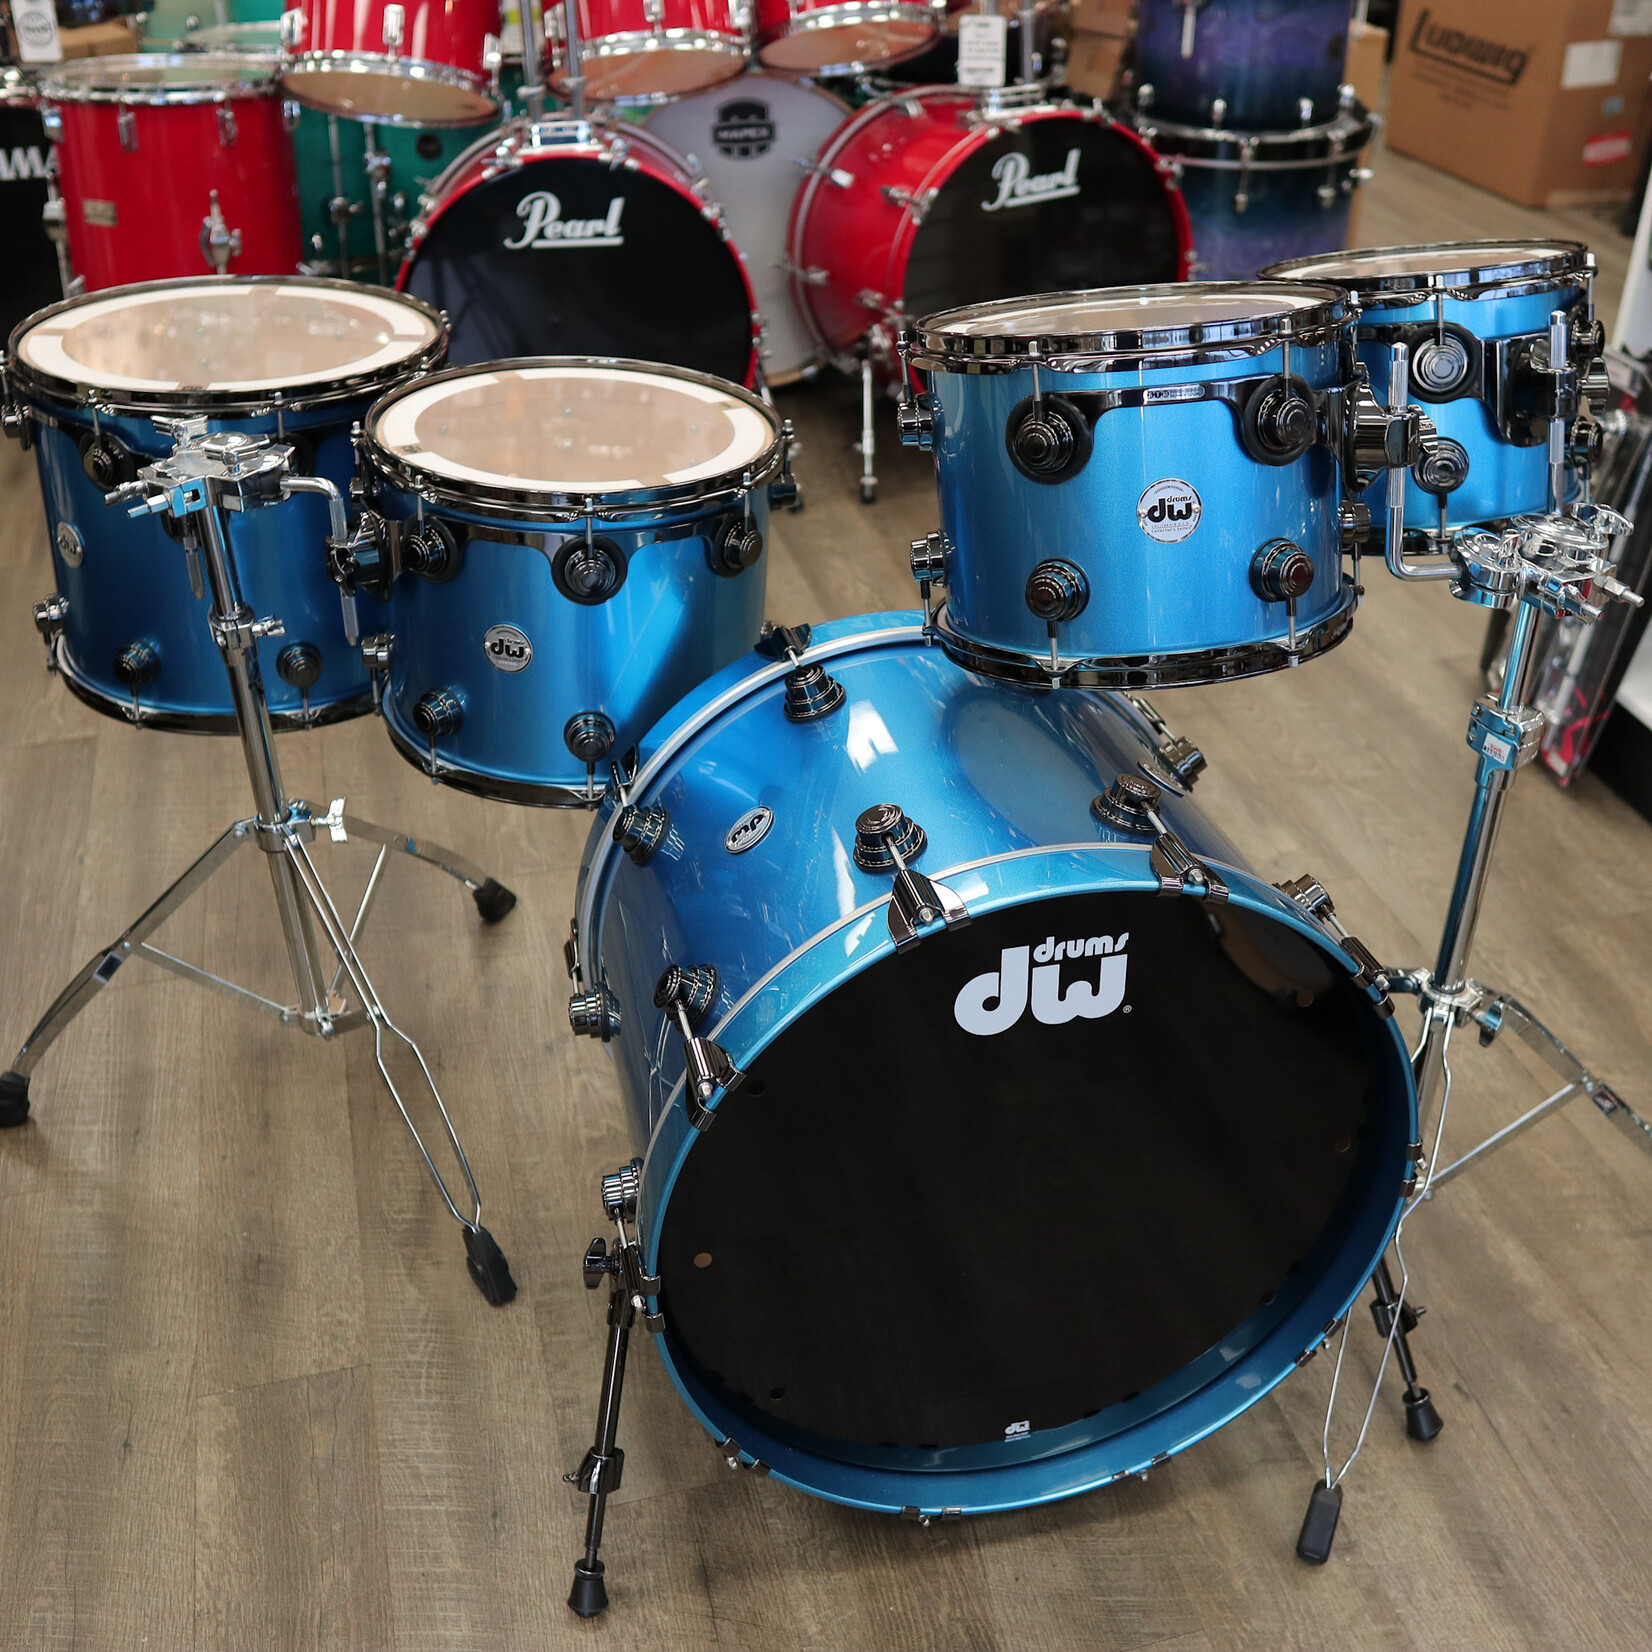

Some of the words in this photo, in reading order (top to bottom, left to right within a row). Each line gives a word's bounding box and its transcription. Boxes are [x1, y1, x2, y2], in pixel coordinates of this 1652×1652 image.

[980, 147, 1081, 212] Pearl
[503, 190, 625, 249] Pearl
[1147, 497, 1192, 523] dw
[490, 638, 525, 659] dw
[1033, 932, 1130, 963] drums
[954, 945, 1128, 1036] dw
